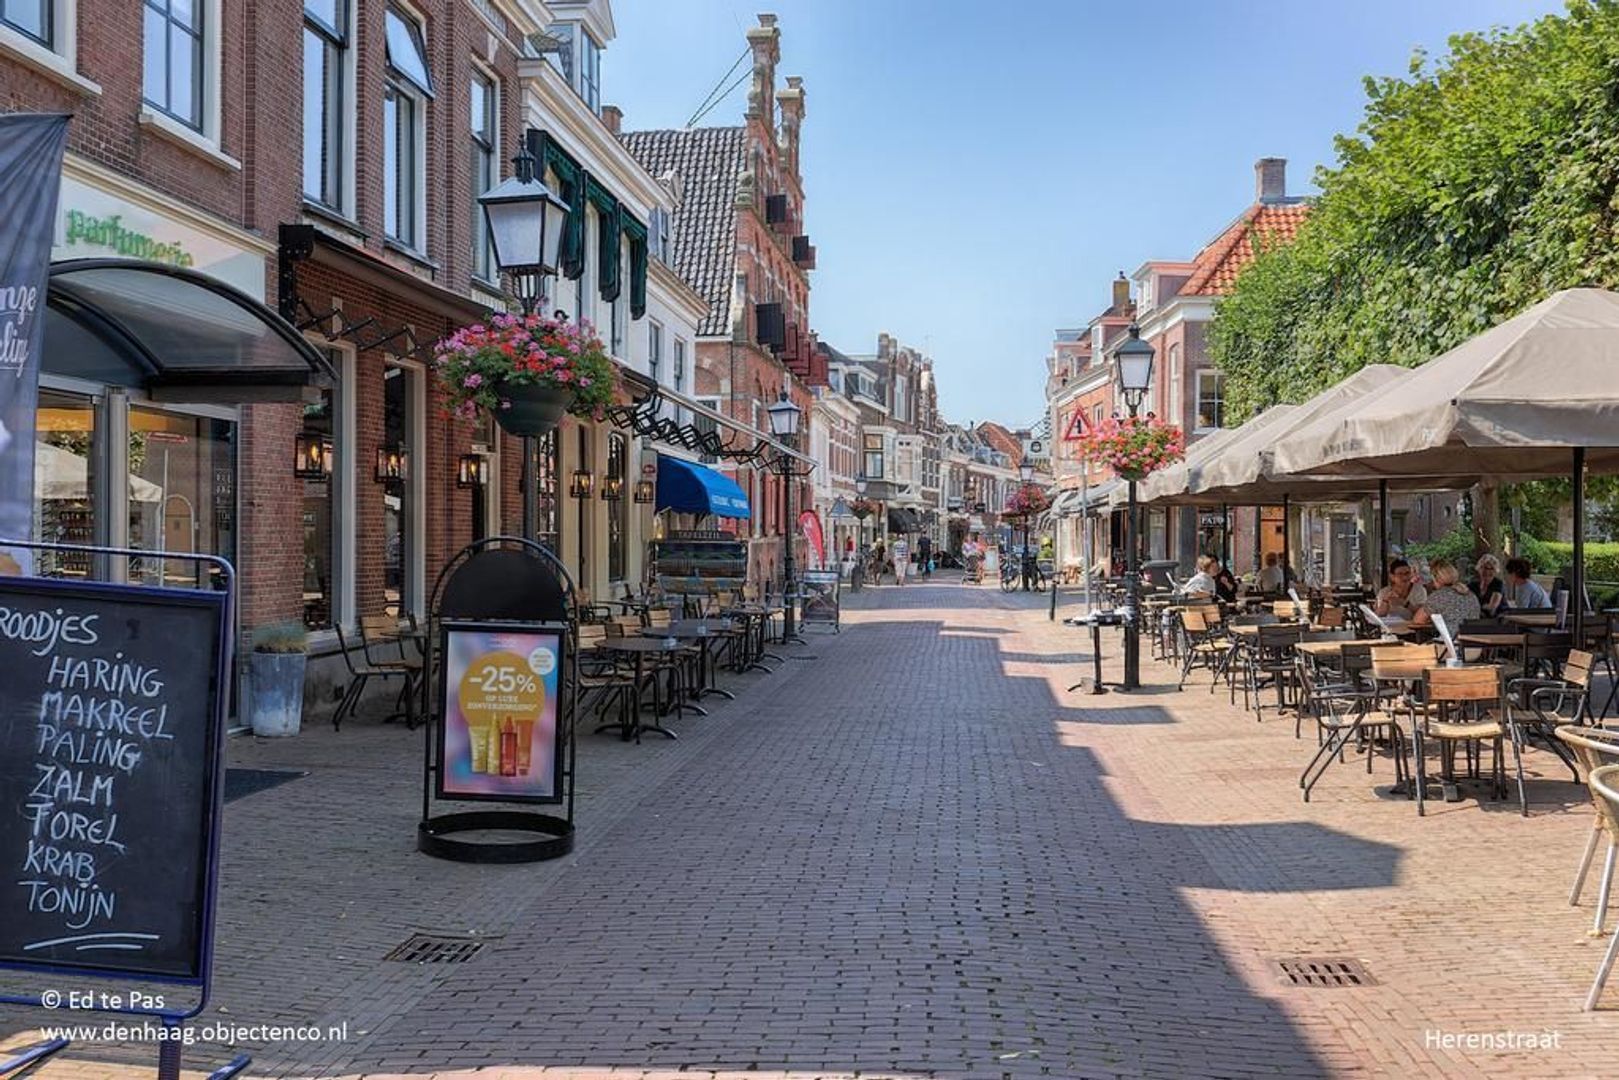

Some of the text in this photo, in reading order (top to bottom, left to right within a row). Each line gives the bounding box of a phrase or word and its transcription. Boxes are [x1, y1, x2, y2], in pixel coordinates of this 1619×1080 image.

[469, 666, 536, 693] -25%
[39, 691, 174, 740] MAKREEL
[29, 763, 115, 807] ZALM
[23, 839, 95, 882] KRAB
